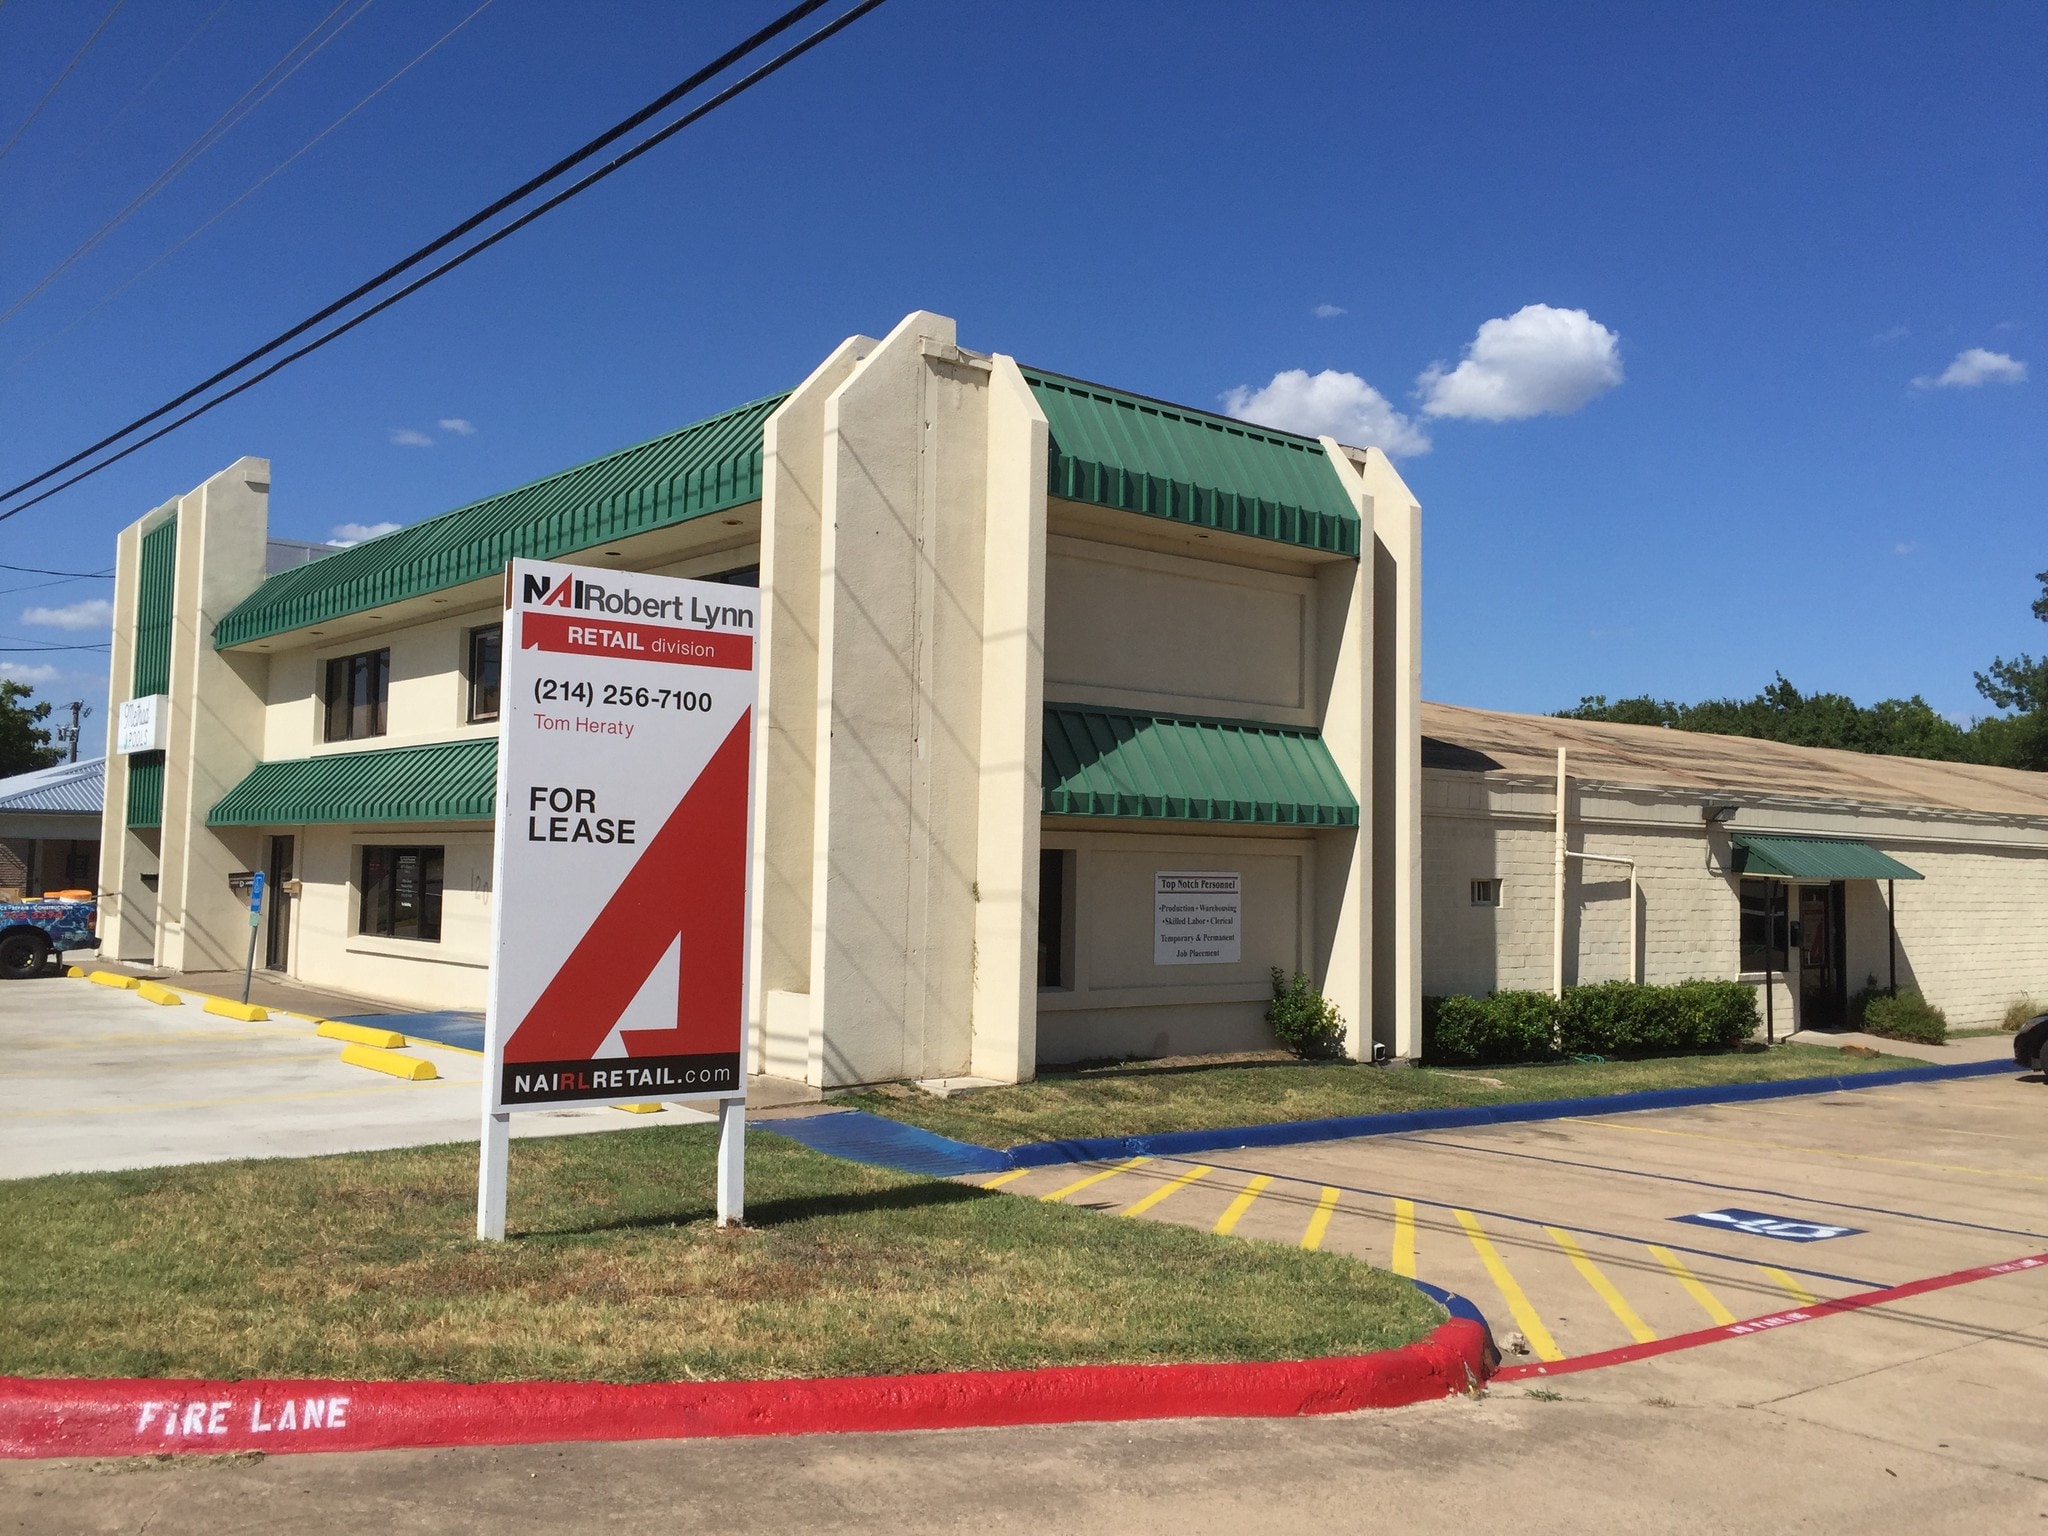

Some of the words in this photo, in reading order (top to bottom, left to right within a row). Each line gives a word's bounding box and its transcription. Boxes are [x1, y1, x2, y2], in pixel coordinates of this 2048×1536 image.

[691, 597, 754, 630] Lynn
[568, 626, 645, 651] RETAIL
[651, 637, 715, 658] division
[534, 677, 594, 707] (214)
[603, 684, 712, 712] 256-7100
[534, 713, 570, 731] Tom
[576, 717, 635, 739] Heraty
[529, 786, 596, 814] FOR
[528, 816, 636, 844] LEASE
[1162, 879, 1176, 890] Top
[1178, 879, 1199, 889] Notch
[1201, 880, 1235, 889] Personnel
[1187, 917, 1206, 925] Labor
[1210, 917, 1234, 925] Clerical
[1200, 904, 1237, 913] Warehousing
[1160, 934, 1194, 944] Temporary
[1195, 934, 1201, 942] &
[1203, 933, 1235, 942] Permanent
[1176, 949, 1188, 958] Job
[1189, 949, 1220, 958] Placement
[514, 1066, 730, 1093] NAIRLRETAIL.com
[136, 1400, 232, 1436] FIRE
[251, 1397, 350, 1433] LANE
